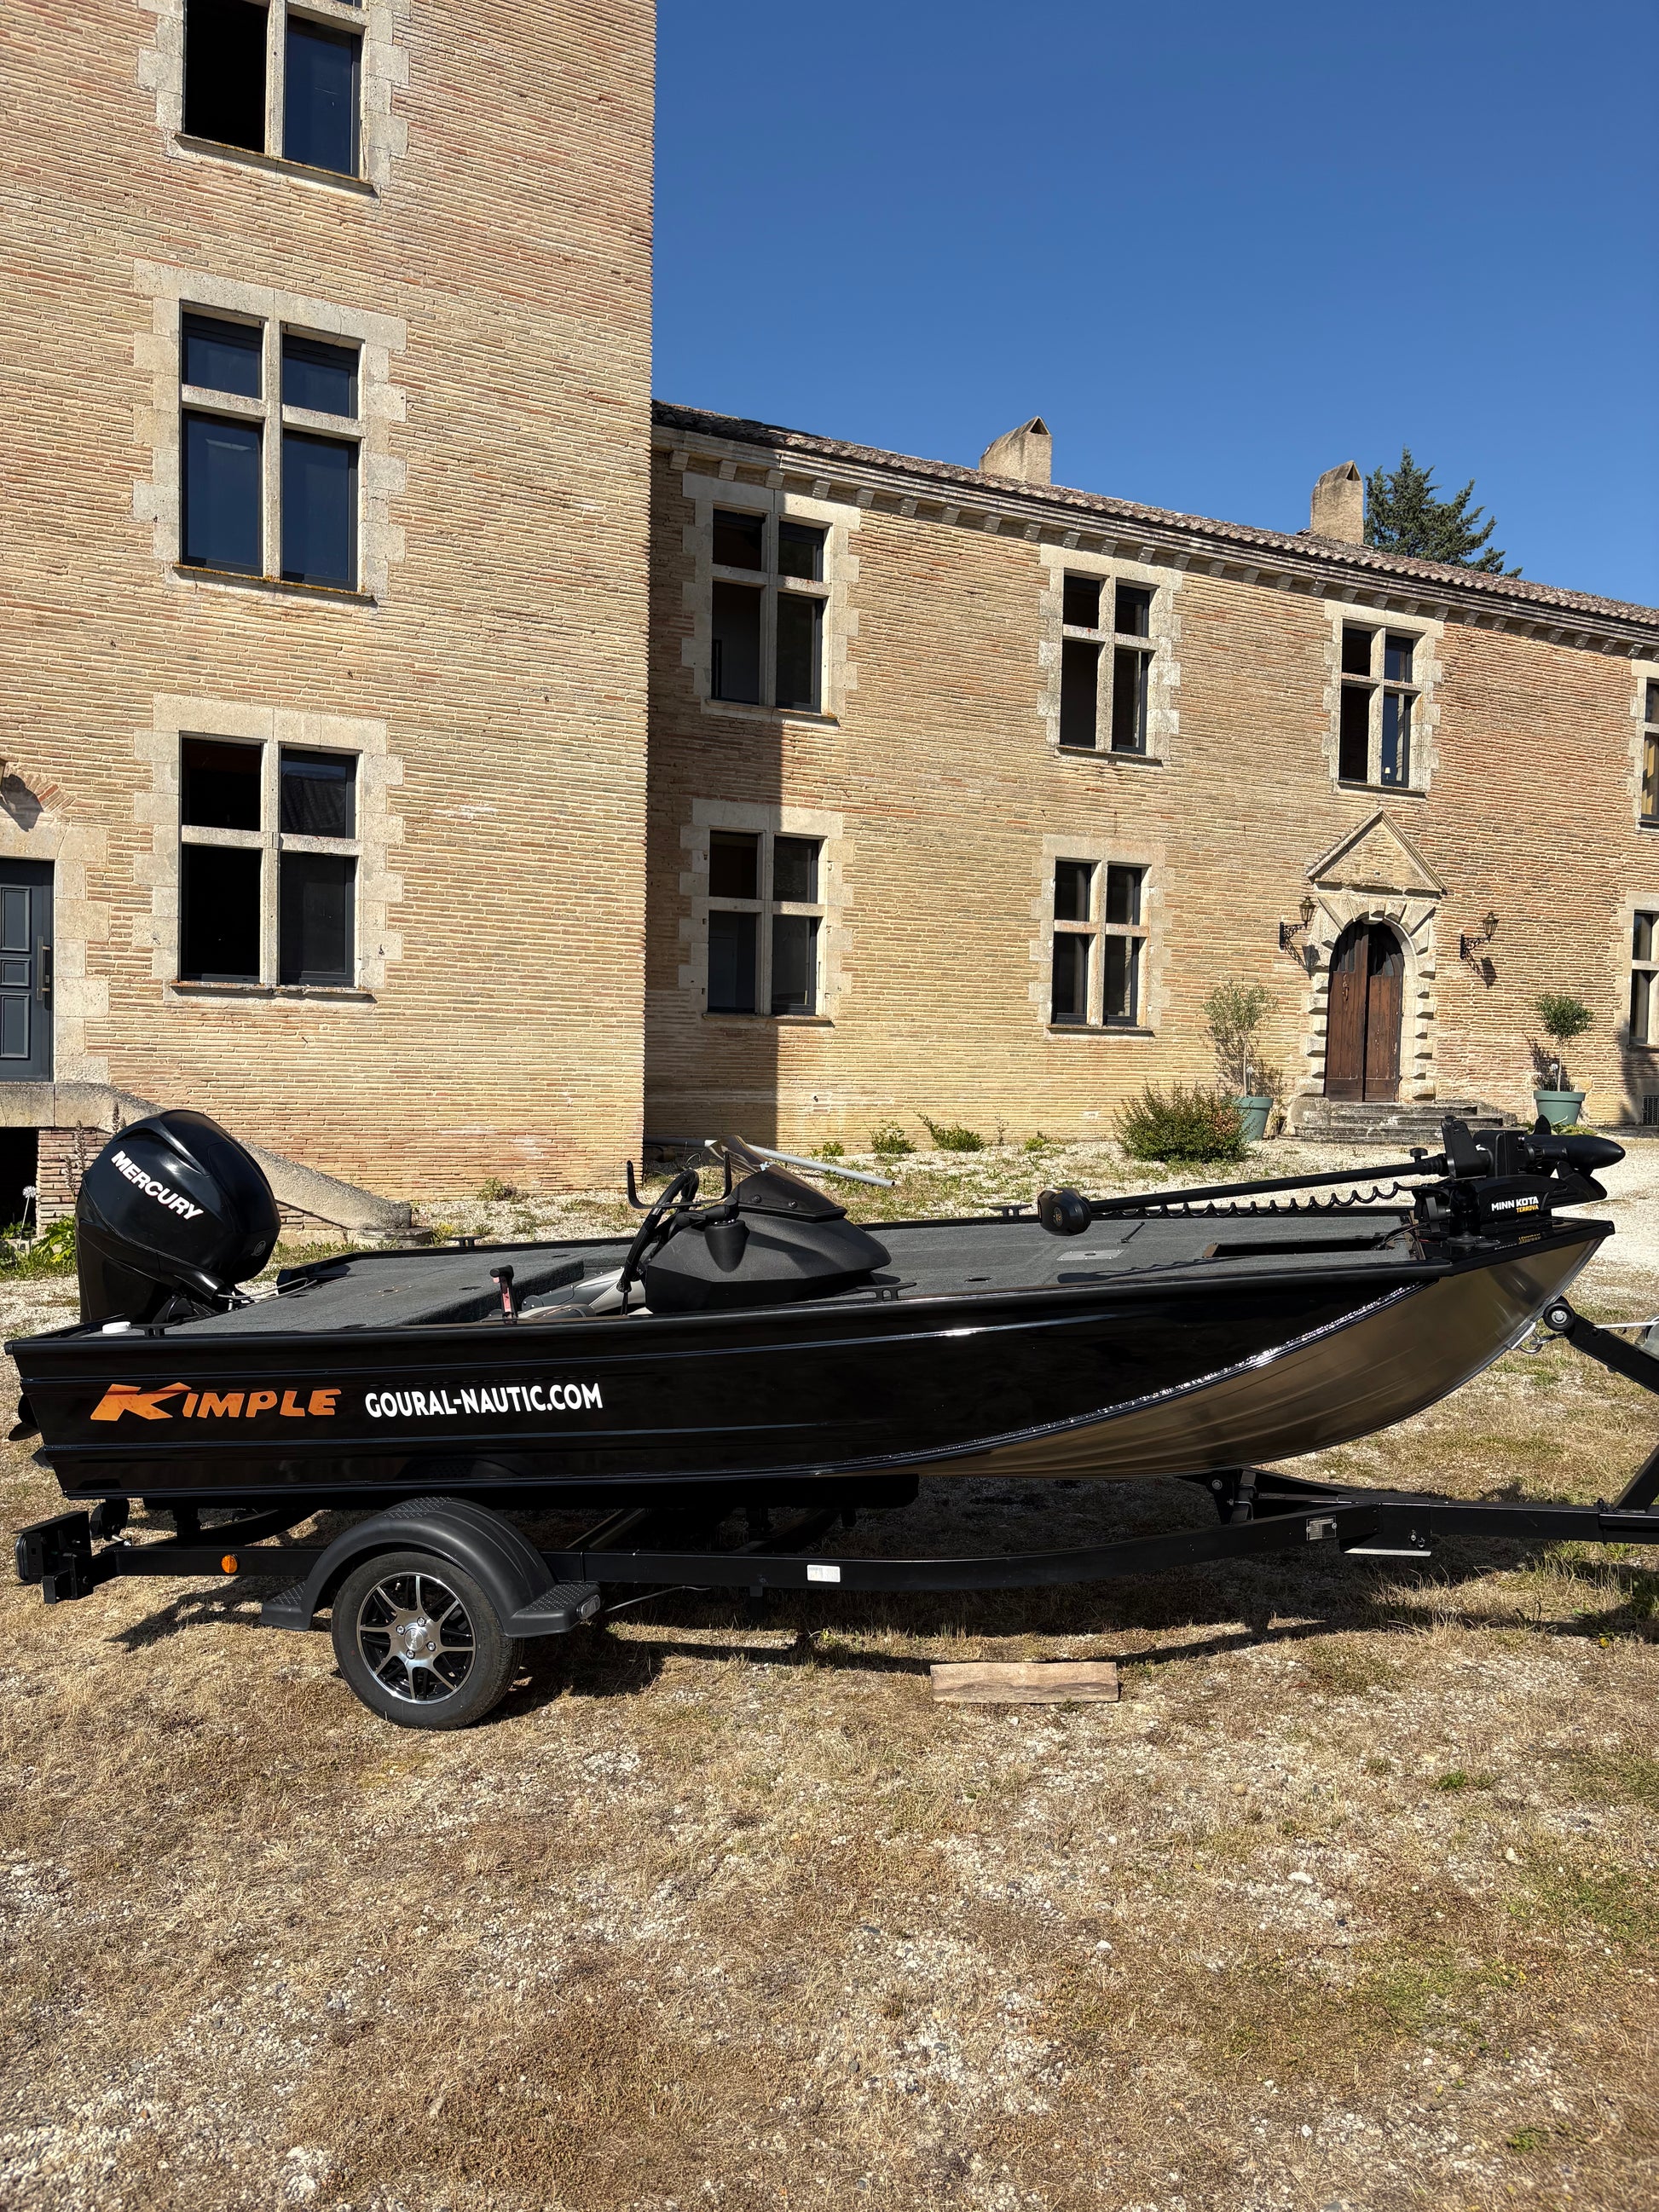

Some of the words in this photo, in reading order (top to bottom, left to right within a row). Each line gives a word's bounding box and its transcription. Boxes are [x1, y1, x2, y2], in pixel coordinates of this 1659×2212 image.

[111, 1150, 205, 1220] MERCURY
[1491, 1199, 1515, 1211] MINN
[1516, 1196, 1539, 1207] KOTA
[1516, 1204, 1539, 1213] TERROVA
[90, 1382, 341, 1421] KIMPLE
[365, 1383, 604, 1418] GOURAL-NAUTIC.COM
